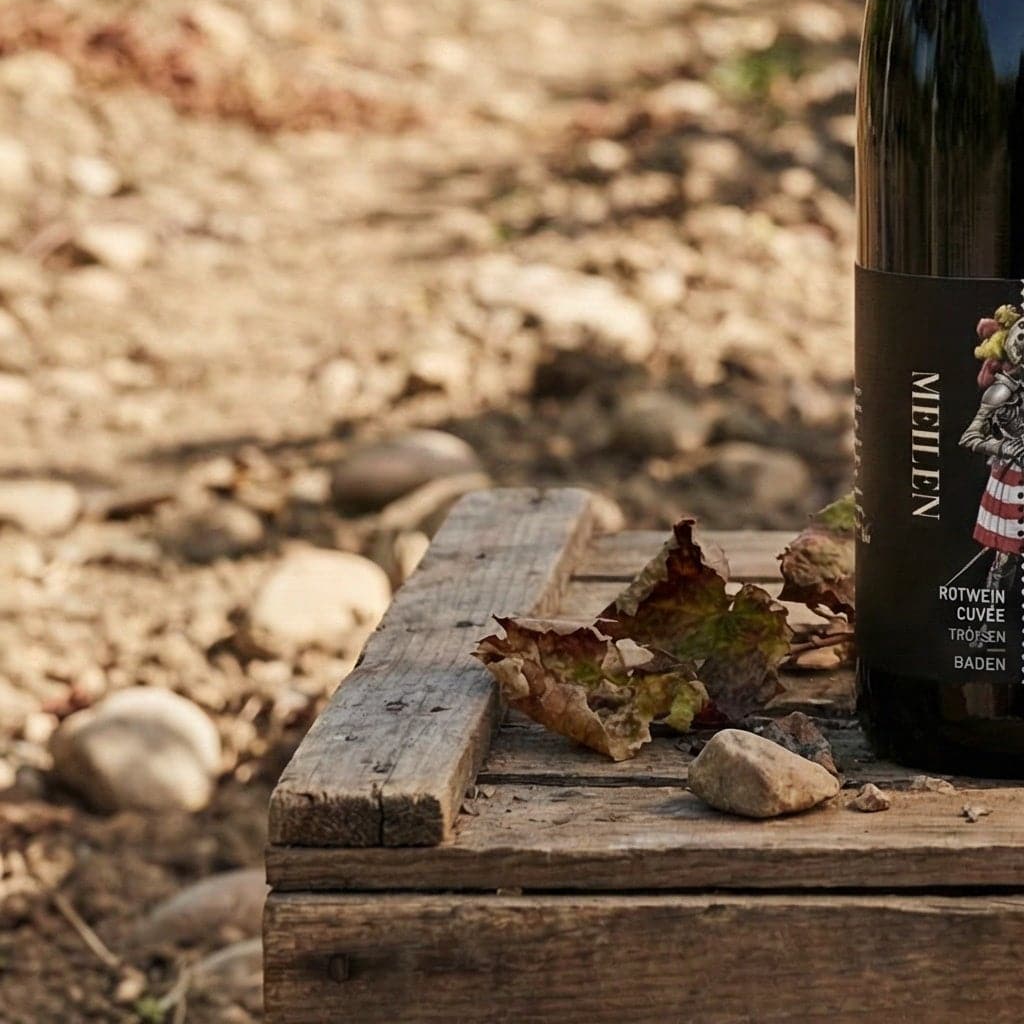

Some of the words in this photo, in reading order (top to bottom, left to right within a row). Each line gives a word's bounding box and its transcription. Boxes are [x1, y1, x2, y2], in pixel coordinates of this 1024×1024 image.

[911, 371, 940, 520] MEILEN
[939, 585, 1005, 604] ROTWEIN
[956, 604, 1006, 623] CUVÉE
[954, 655, 1006, 671] BADEN
